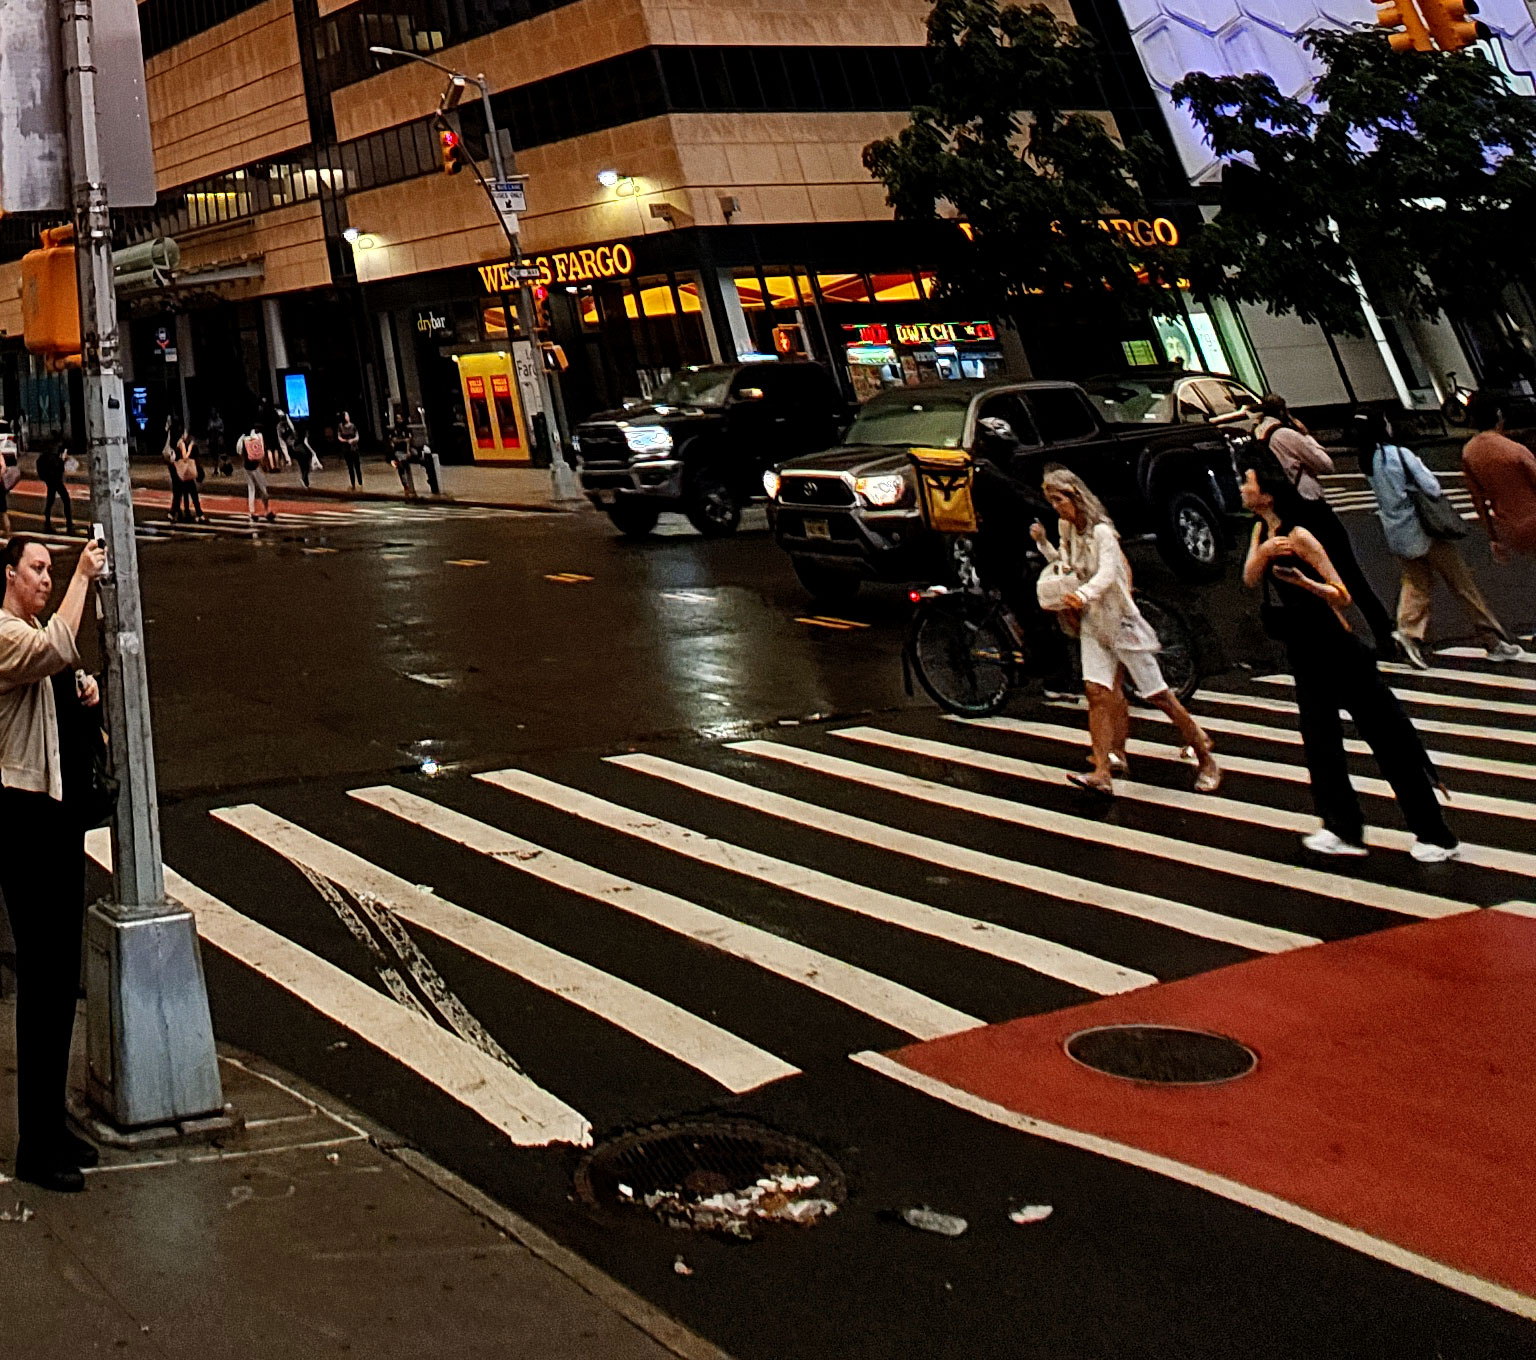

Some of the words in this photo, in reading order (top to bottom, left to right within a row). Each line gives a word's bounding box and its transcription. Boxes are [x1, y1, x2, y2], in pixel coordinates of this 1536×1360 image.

[477, 256, 552, 294] WES
[552, 243, 632, 283] FARGO
[417, 311, 445, 338] drybar
